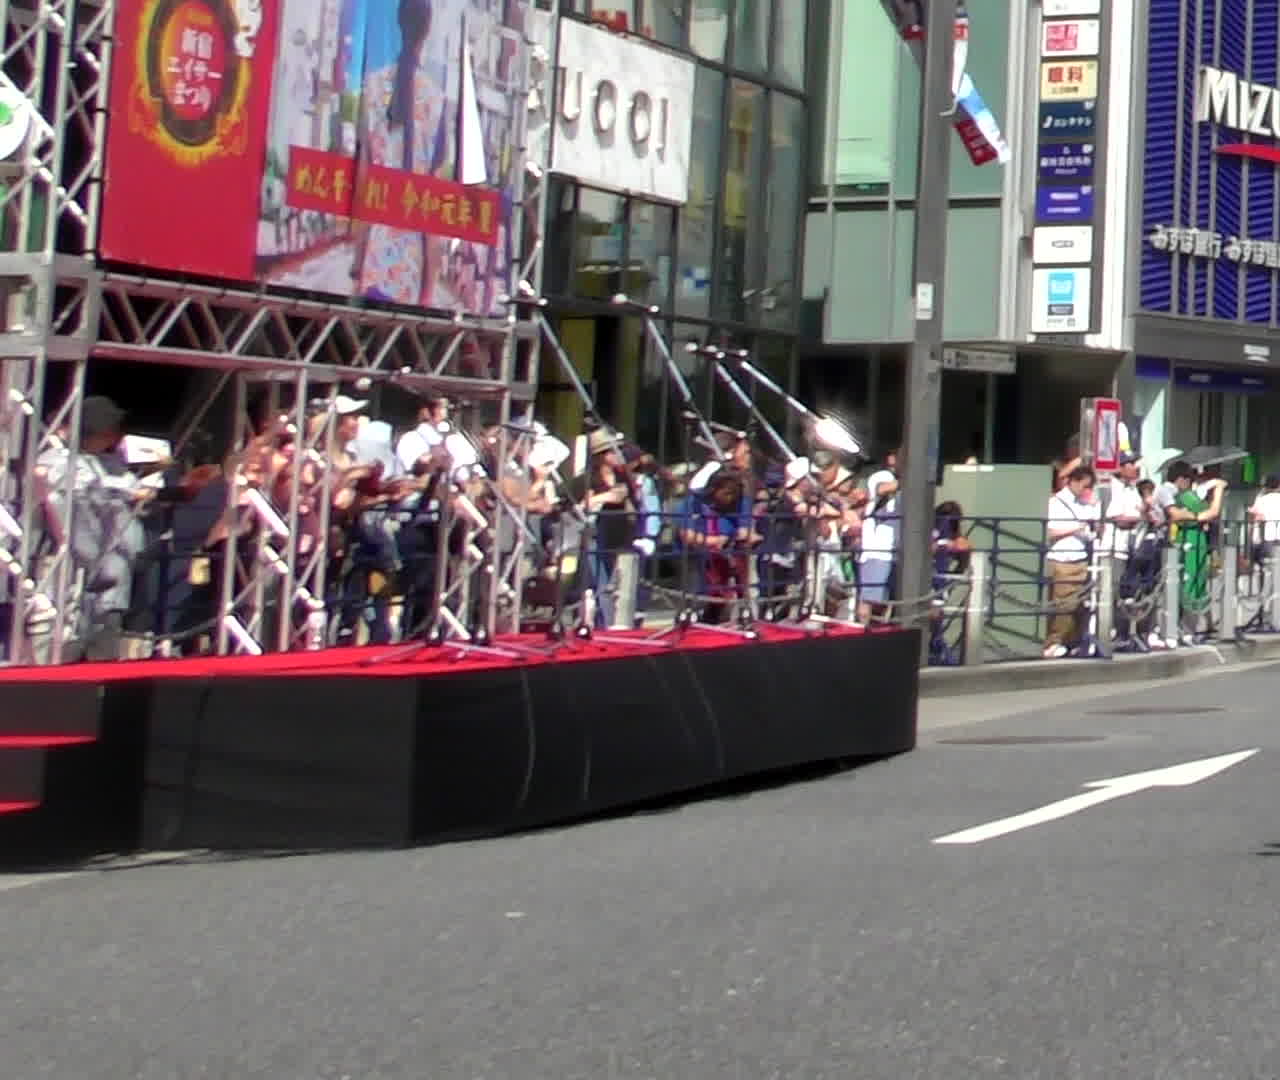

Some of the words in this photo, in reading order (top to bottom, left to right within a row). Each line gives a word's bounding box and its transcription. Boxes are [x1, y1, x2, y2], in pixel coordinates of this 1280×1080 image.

[1150, 224, 1223, 260] みずほ銀行
